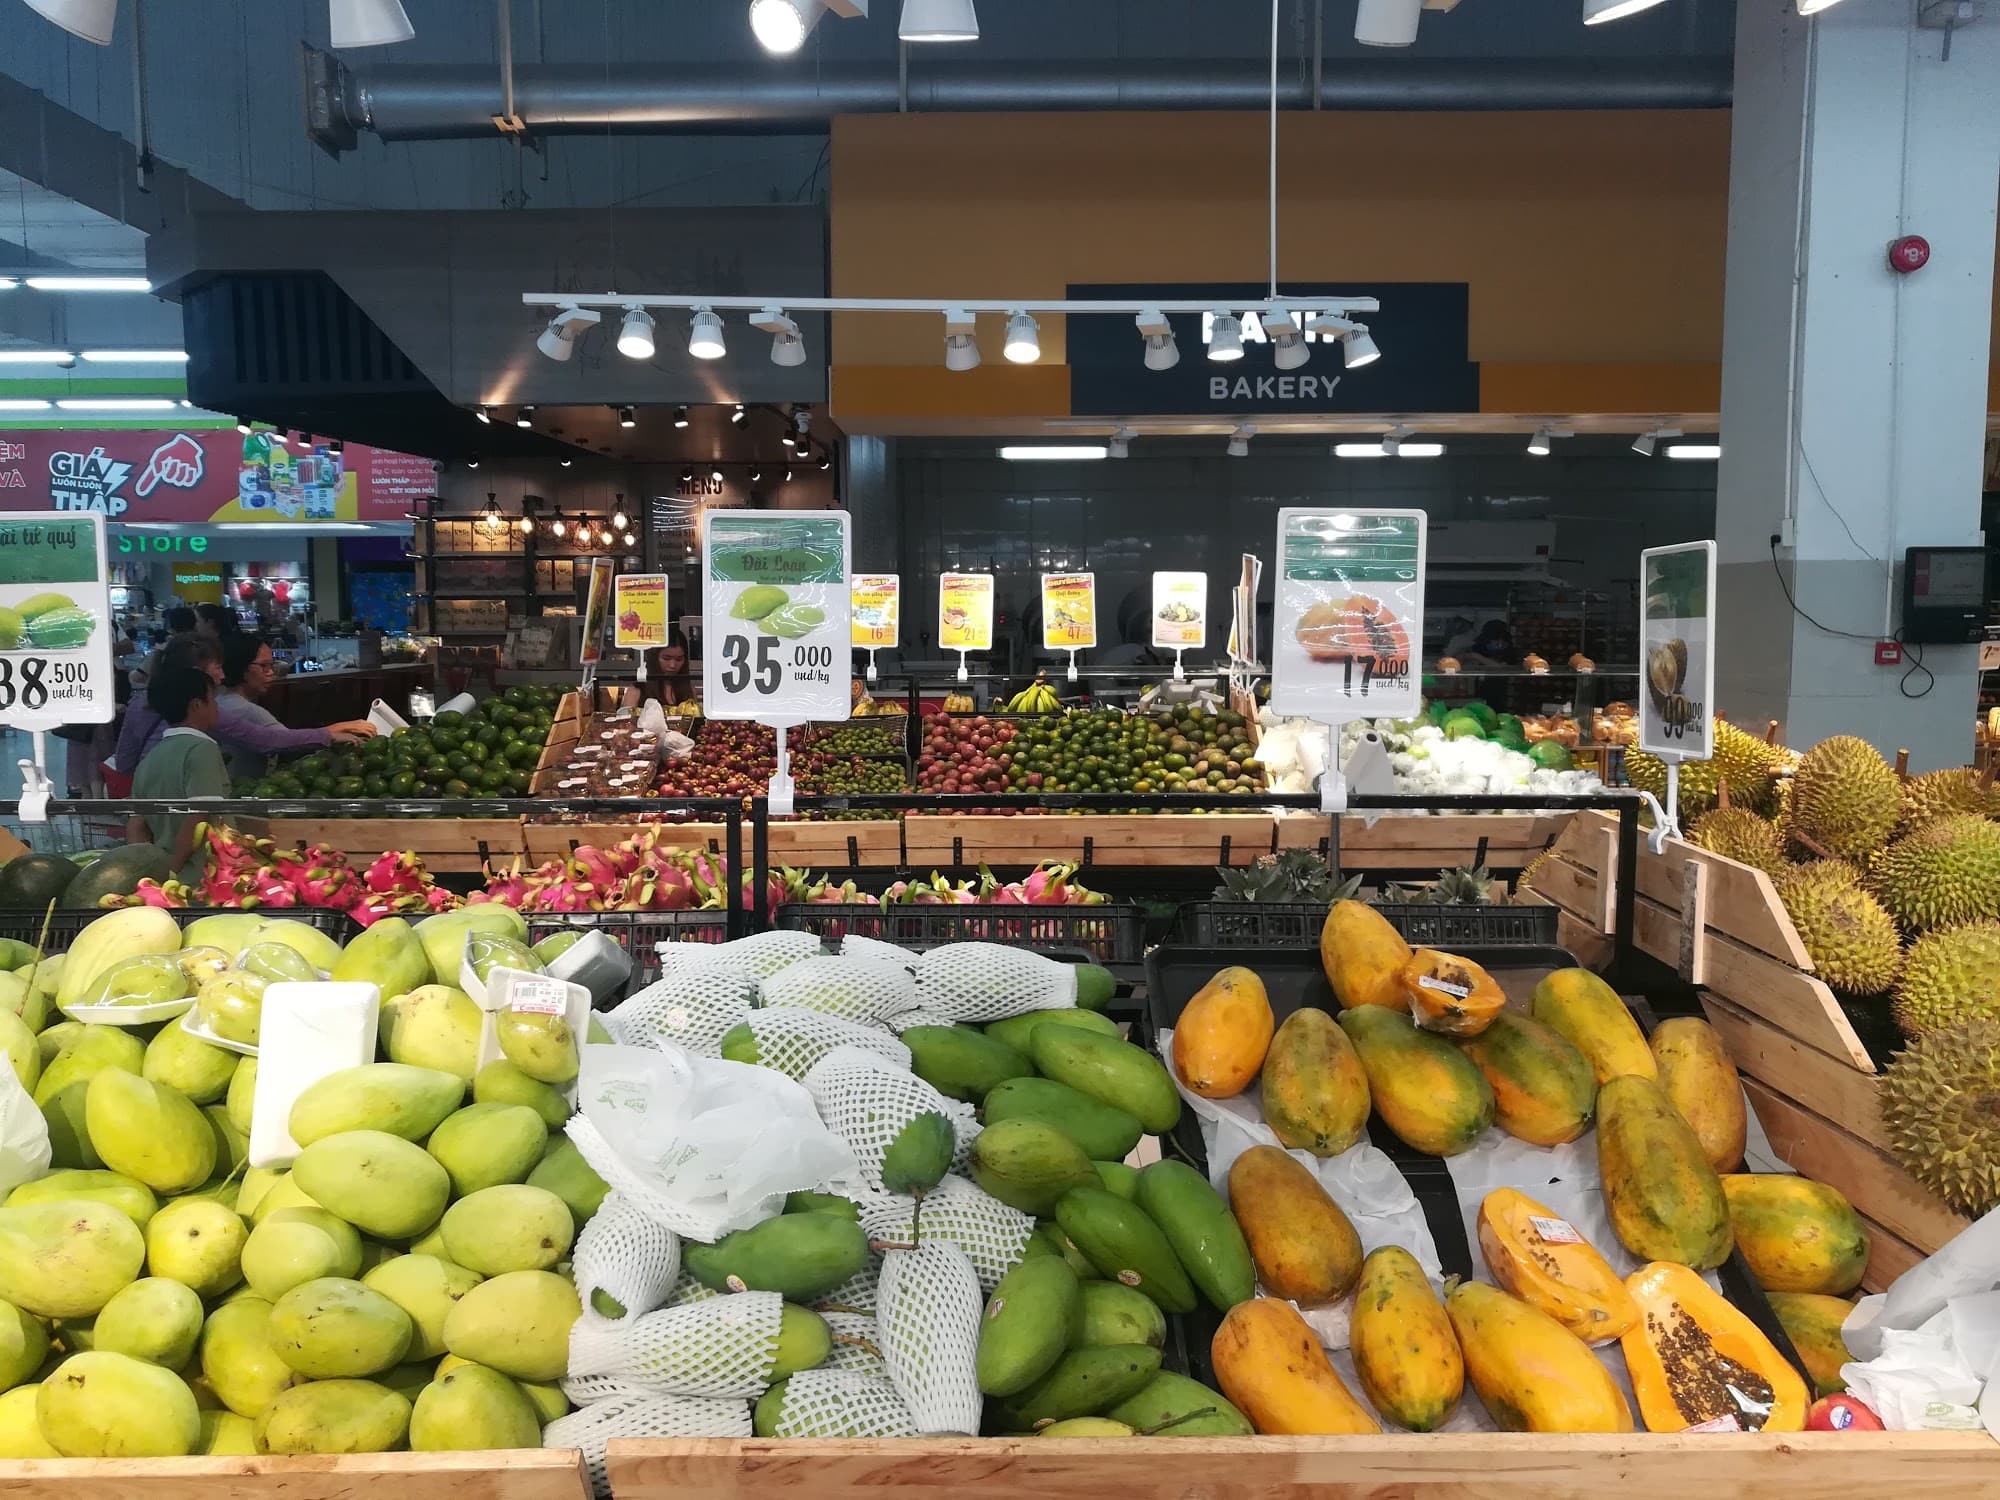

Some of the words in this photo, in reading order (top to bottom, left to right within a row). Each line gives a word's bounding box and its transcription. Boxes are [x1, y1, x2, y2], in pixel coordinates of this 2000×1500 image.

[1210, 376, 1341, 399] BAKERY
[49, 447, 106, 481] GIÁ
[638, 626, 652, 640] 44
[794, 669, 830, 685] vnd/kg
